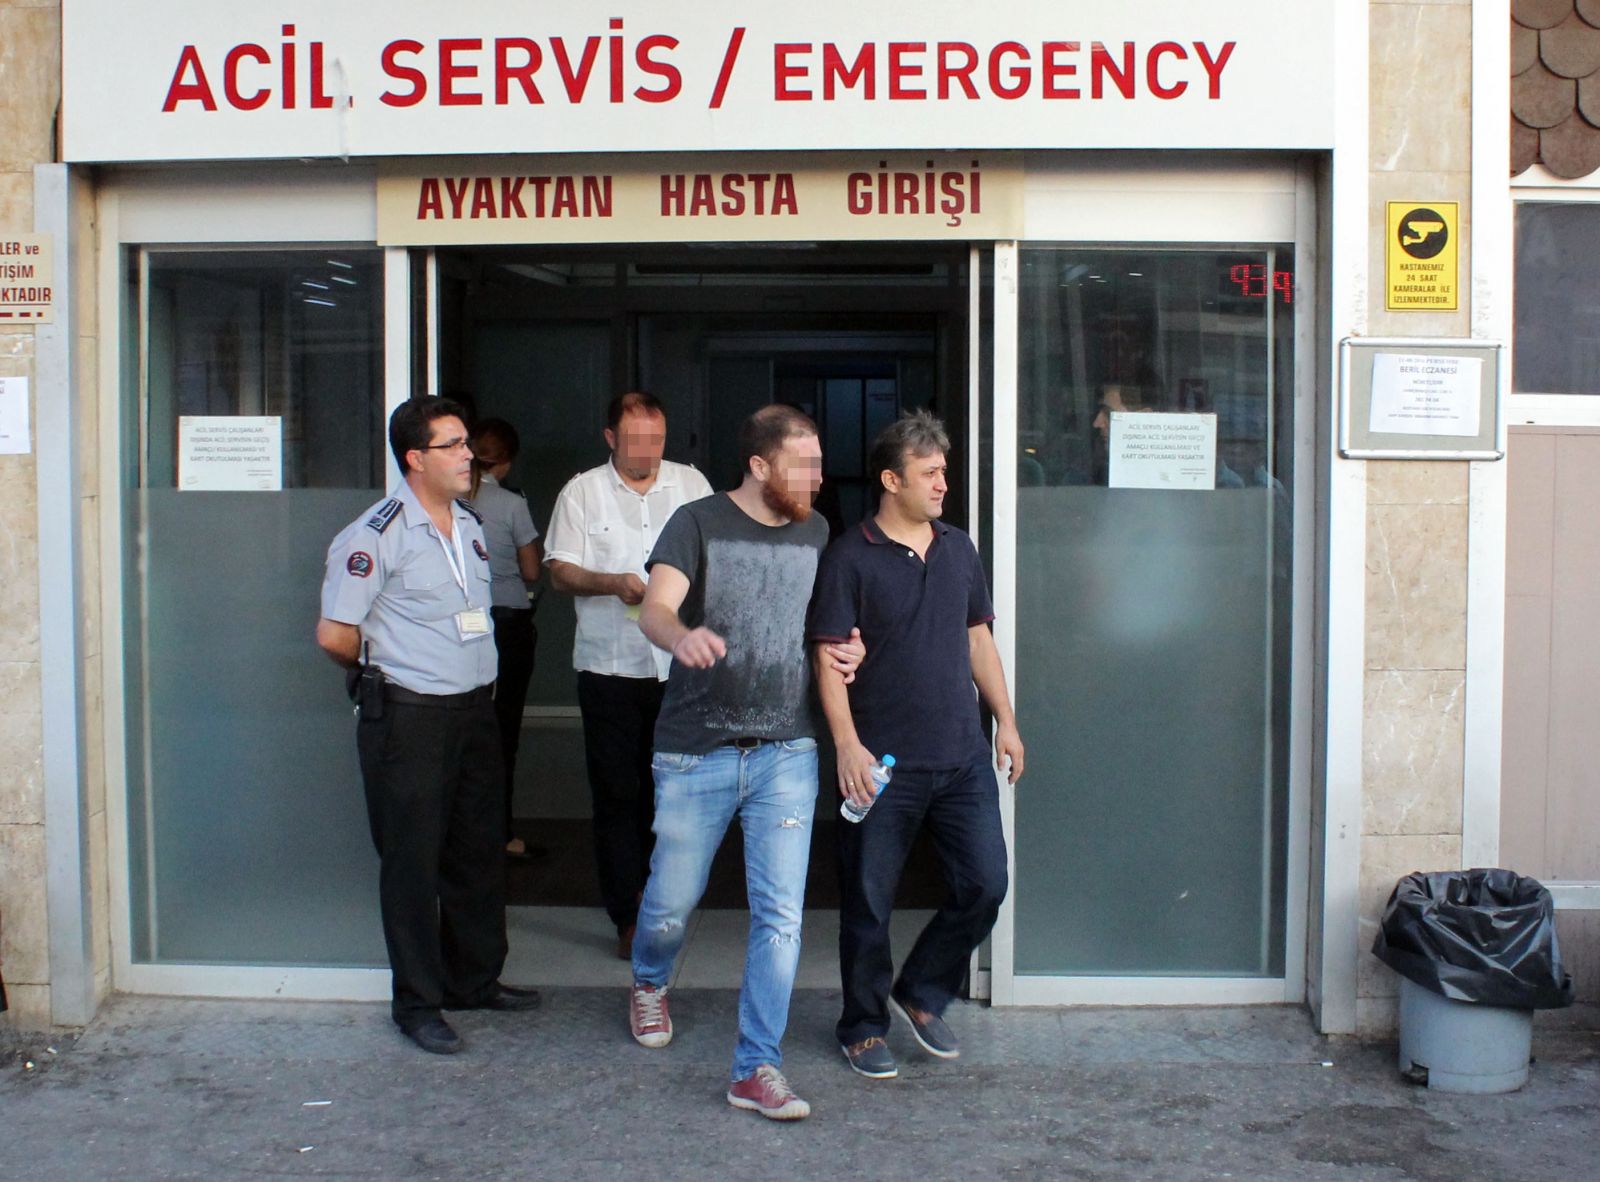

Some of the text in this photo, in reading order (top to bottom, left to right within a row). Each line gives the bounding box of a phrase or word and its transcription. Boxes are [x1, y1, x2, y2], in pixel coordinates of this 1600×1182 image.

[162, 24, 353, 112] ACİL
[379, 17, 682, 107] SERVİS
[774, 40, 1237, 101] EMERGENCY
[417, 160, 981, 227] AYAKTAN HASTA GİRİŞİ
[25, 245, 39, 255] ve
[1394, 285, 1436, 293] KAMERALAR
